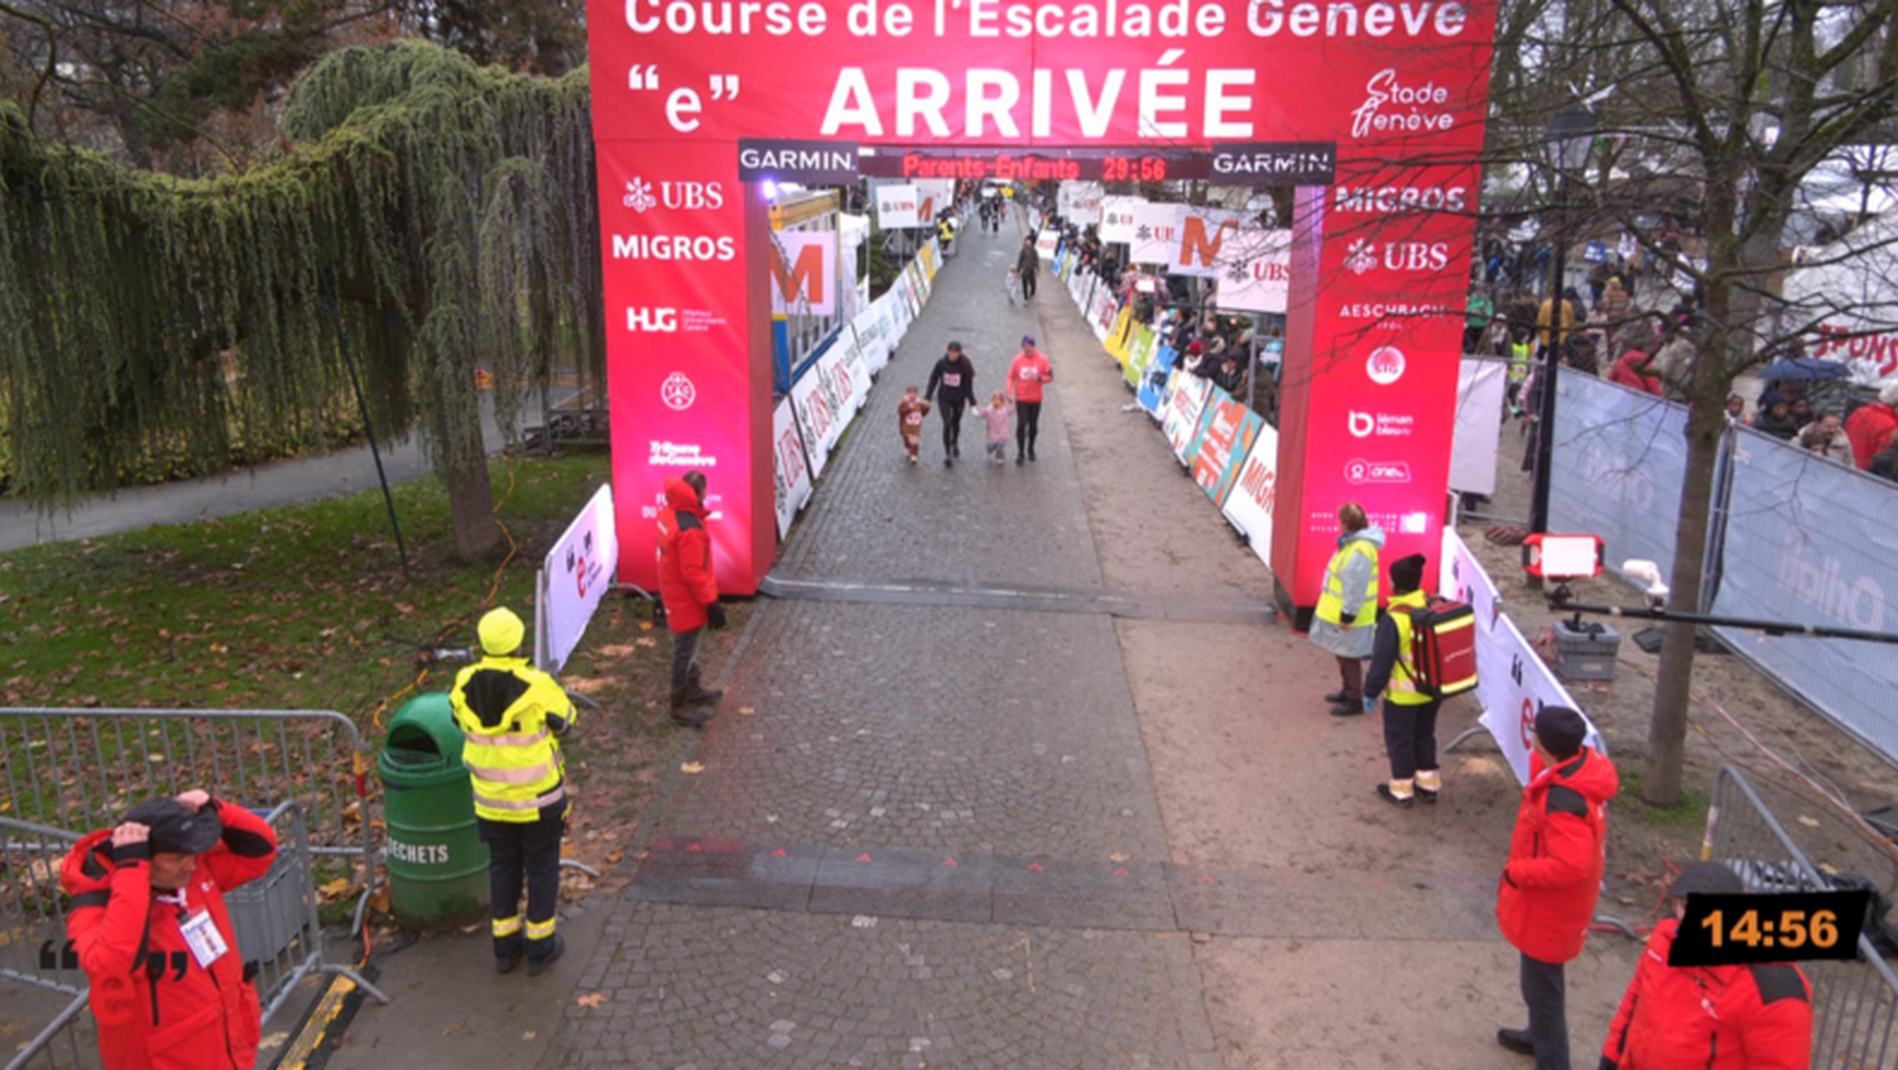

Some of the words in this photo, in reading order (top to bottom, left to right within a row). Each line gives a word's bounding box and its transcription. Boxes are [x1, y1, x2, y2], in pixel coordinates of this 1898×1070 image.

[625, 0, 827, 35] Course
[847, 0, 913, 36] de
[820, 49, 1256, 138] ARRIVÉE
[1367, 68, 1448, 104] Stade
[1351, 97, 1454, 138] Genève
[904, 155, 1080, 180] Parents-Enfants
[1103, 156, 1167, 181] 29:56
[661, 181, 723, 210] UBS
[1335, 187, 1465, 212] MIGROS
[612, 234, 735, 260] MIGROS
[1385, 242, 1448, 271] UBS
[627, 307, 677, 332] HUG
